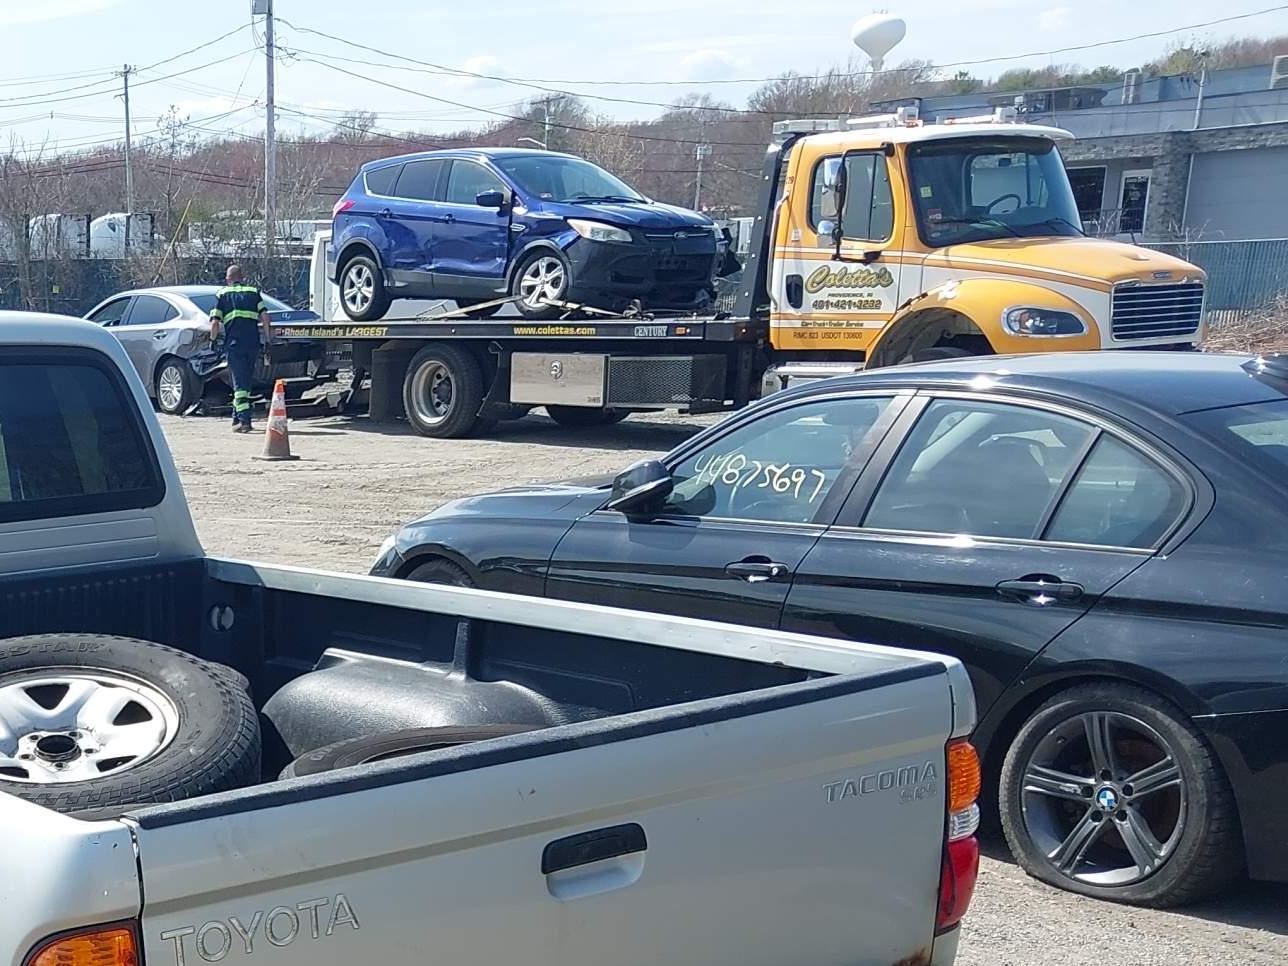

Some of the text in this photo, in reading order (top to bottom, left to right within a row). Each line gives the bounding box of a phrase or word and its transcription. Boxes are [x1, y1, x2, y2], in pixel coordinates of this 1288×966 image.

[806, 265, 894, 293] Coletta's
[284, 327, 309, 336] Rhode
[312, 327, 343, 336] Island's
[346, 327, 388, 336] LARGEST
[513, 325, 596, 335] www.colettas.com
[634, 325, 667, 337] CENTURY
[821, 331, 841, 339] USDOT
[694, 453, 825, 503] 44875697
[823, 760, 937, 804] TACOMA
